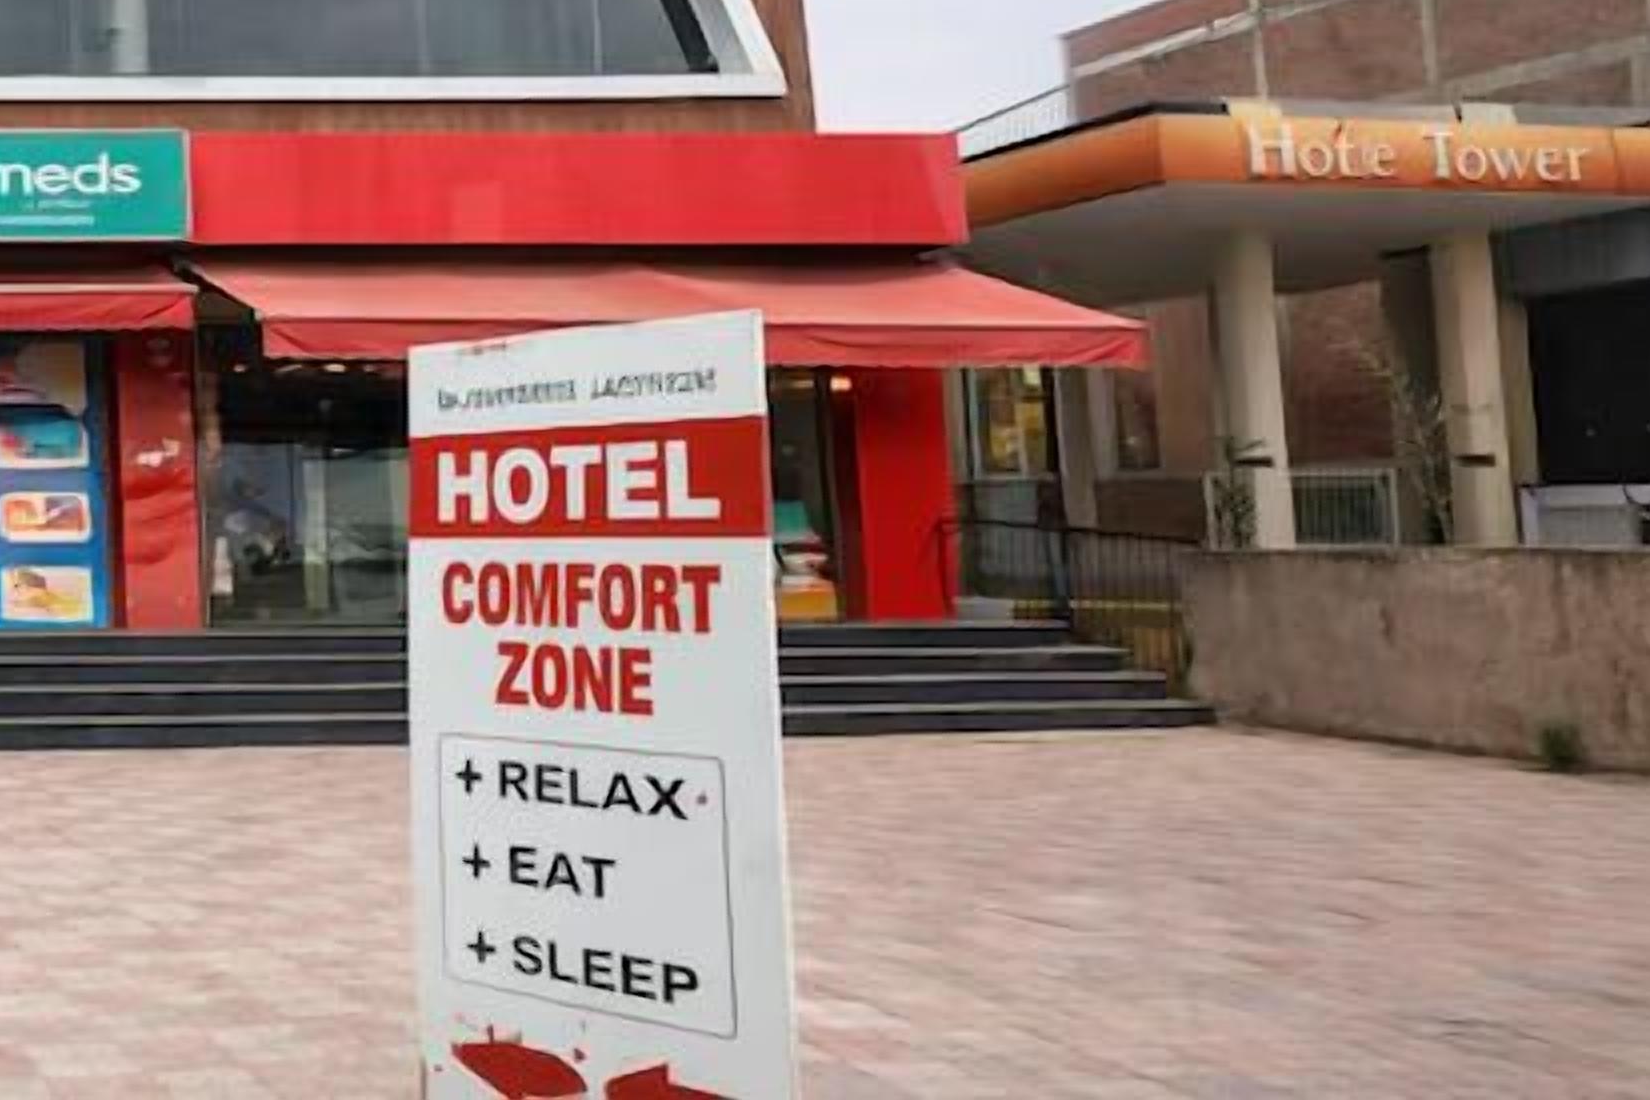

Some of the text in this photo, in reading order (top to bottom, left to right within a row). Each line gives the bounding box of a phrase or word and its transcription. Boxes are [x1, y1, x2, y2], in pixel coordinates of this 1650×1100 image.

[1422, 130, 1586, 182] Tower
[438, 440, 721, 524] HOTEL
[442, 562, 721, 634] COMFORT
[495, 642, 654, 716] ZONE
[499, 761, 689, 820] RELAX
[508, 846, 616, 899] EAT
[512, 936, 699, 1005] SLEEP
